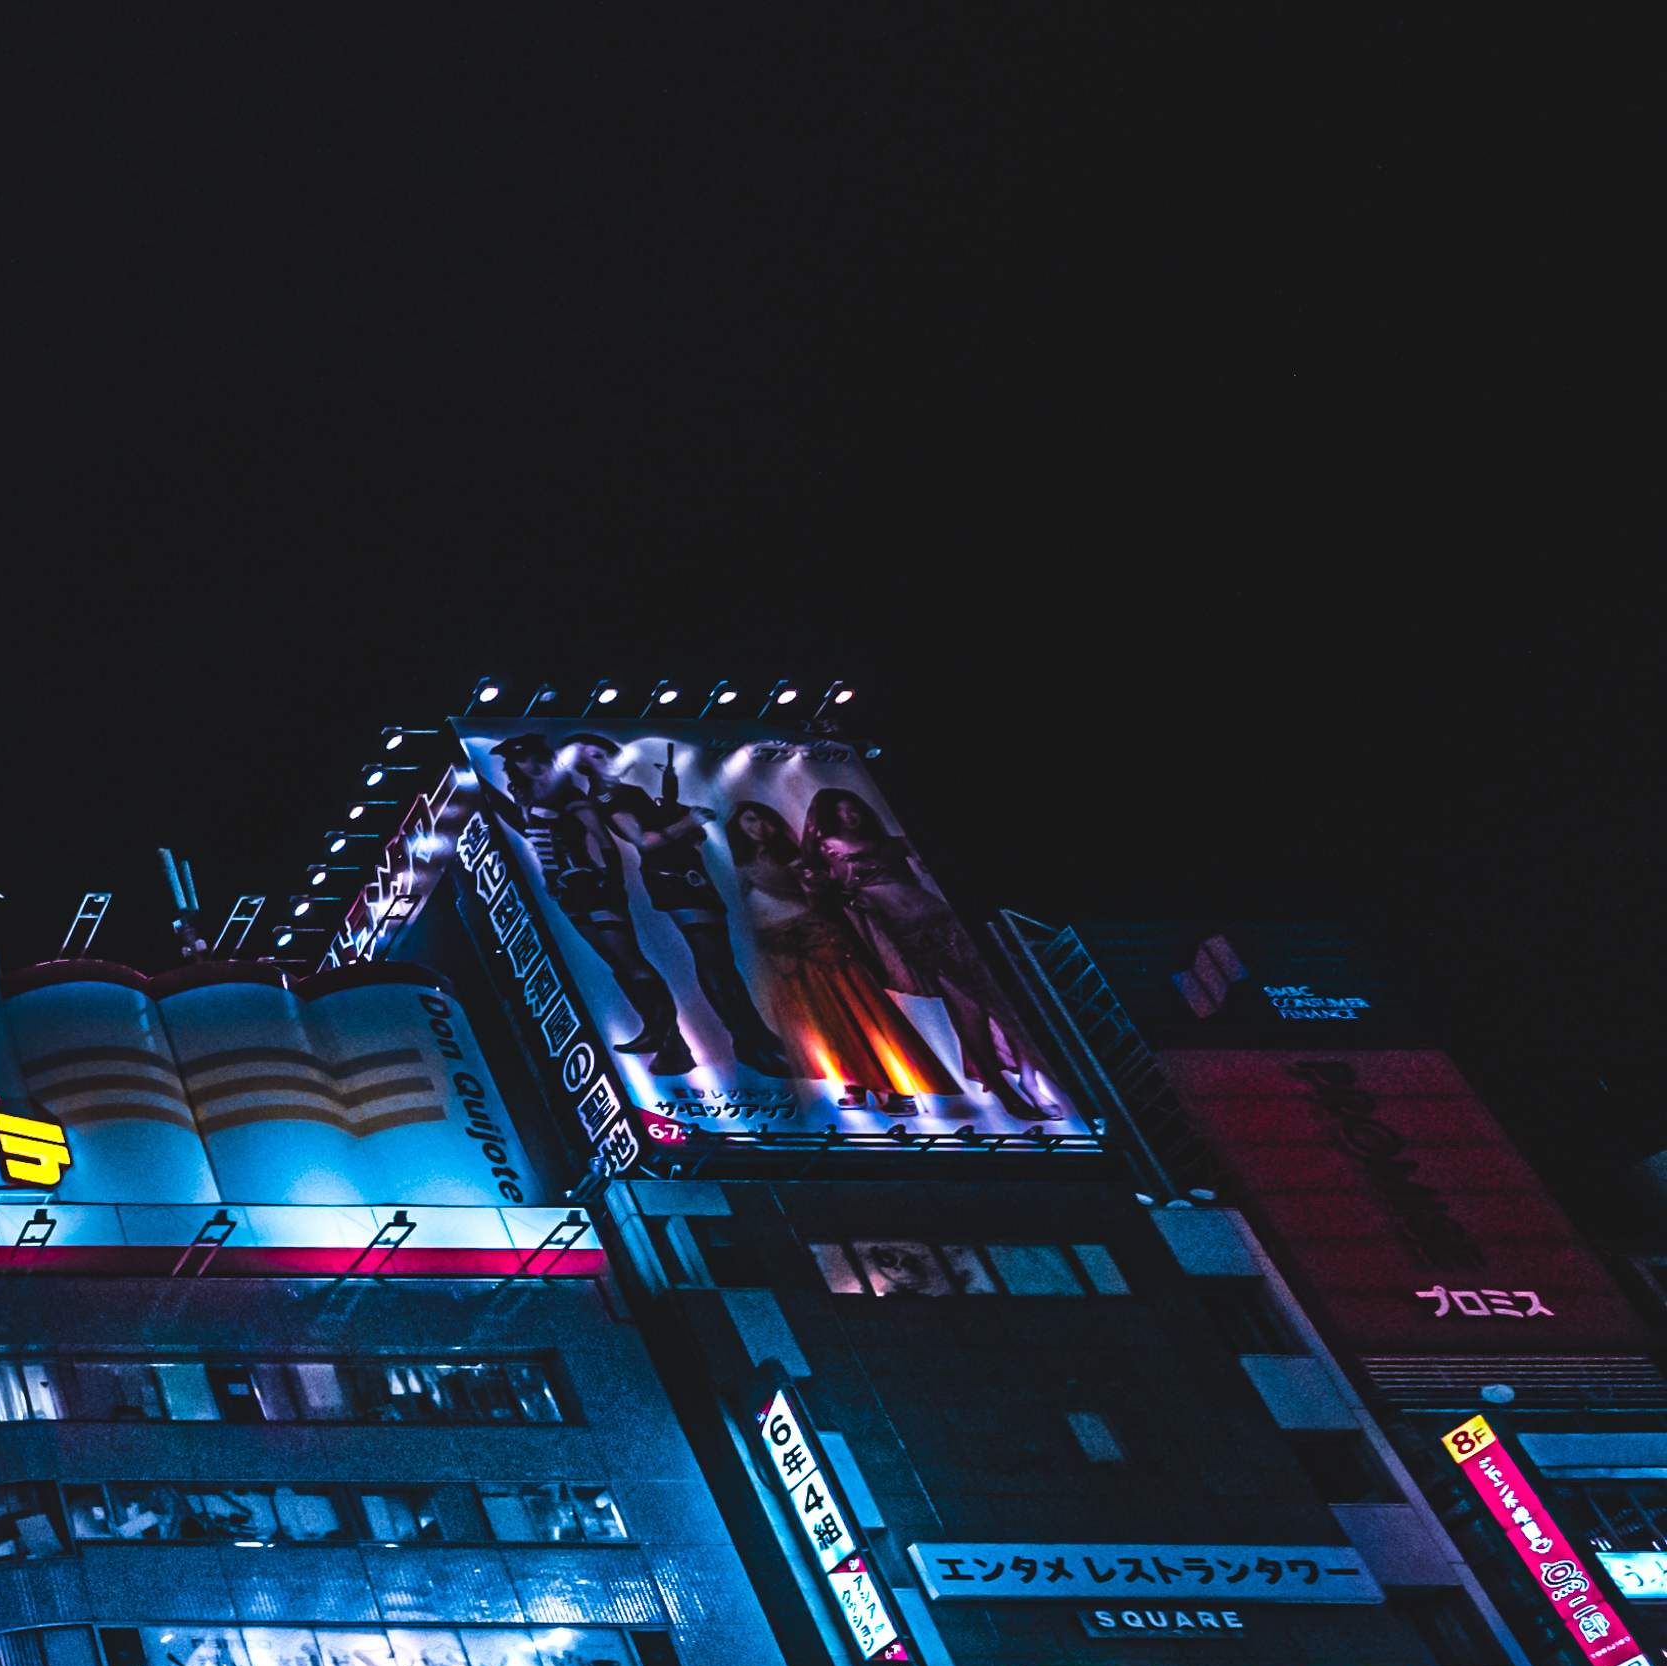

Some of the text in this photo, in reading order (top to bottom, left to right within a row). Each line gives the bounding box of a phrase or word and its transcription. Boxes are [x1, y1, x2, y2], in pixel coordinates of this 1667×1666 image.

[1263, 985, 1315, 998] SMBC
[1271, 997, 1372, 1009] CONSUMER
[1278, 1008, 1359, 1019] FINANCE
[418, 992, 526, 1205] Don Quijote
[1414, 1285, 1555, 1318] プロミス
[1452, 1427, 1489, 1456] 8F
[937, 1555, 1363, 1589] エンタメ レストランタワー
[1095, 1609, 1245, 1633] SQUARE
